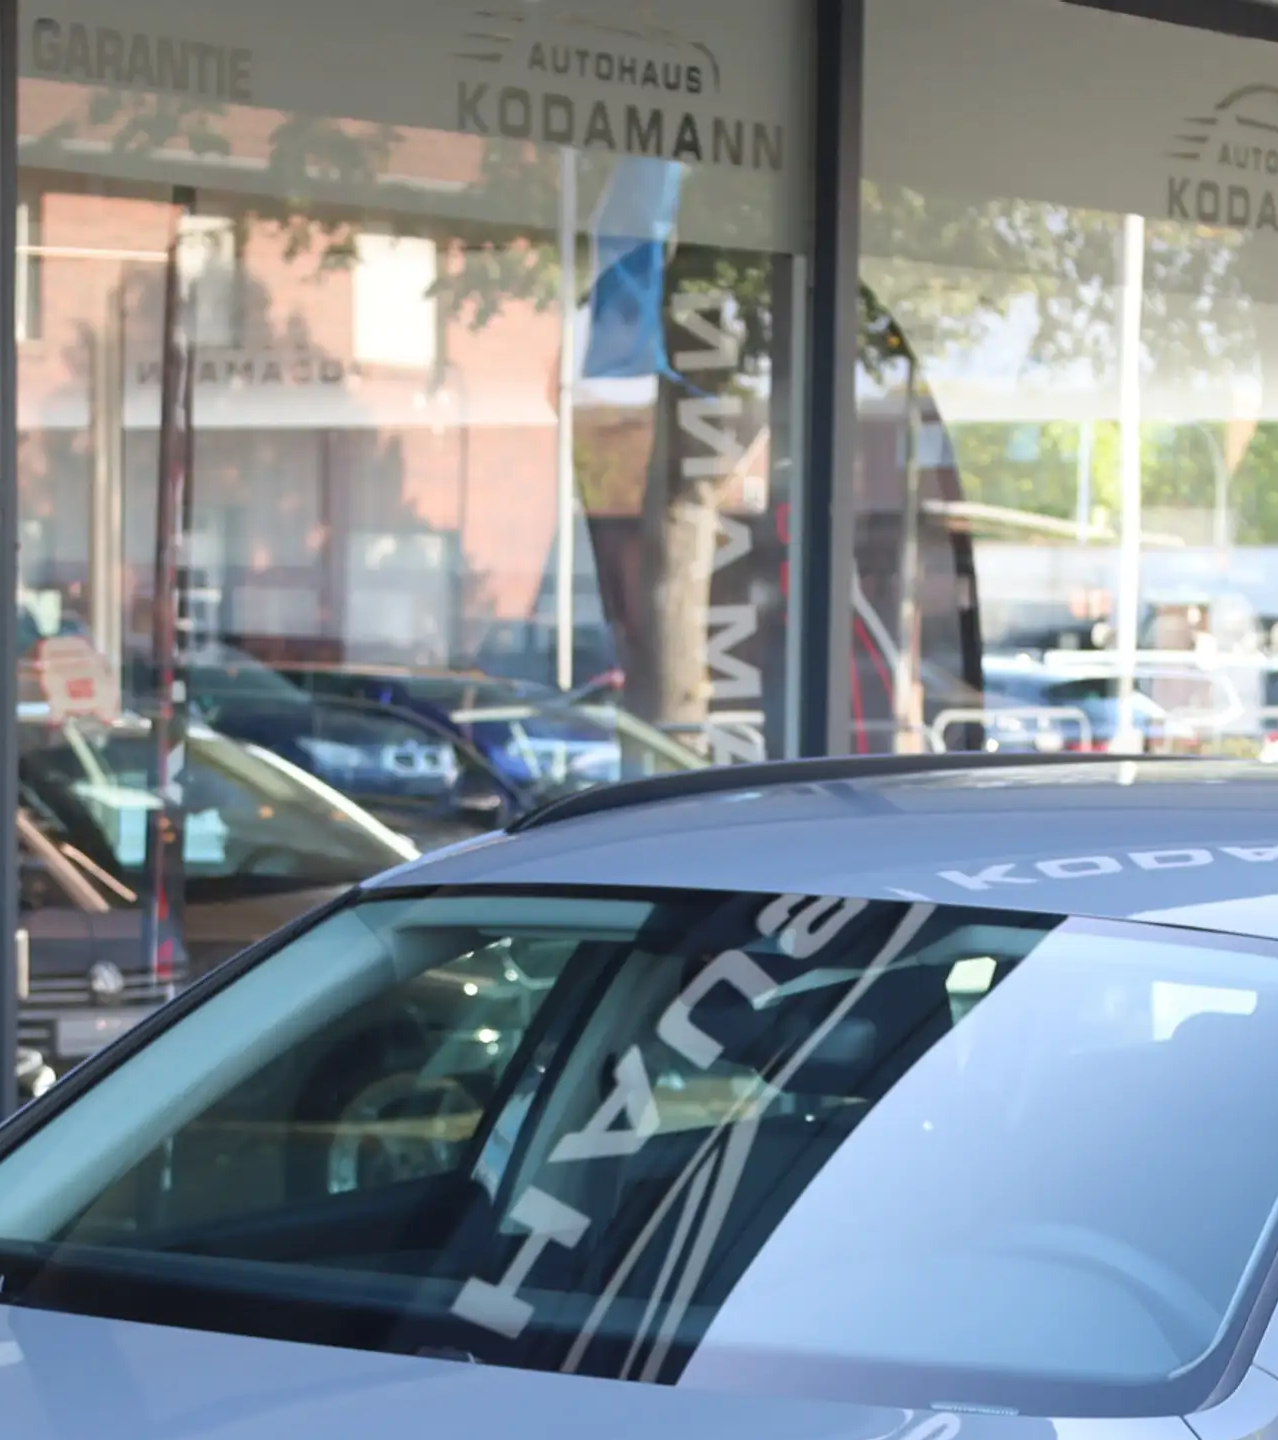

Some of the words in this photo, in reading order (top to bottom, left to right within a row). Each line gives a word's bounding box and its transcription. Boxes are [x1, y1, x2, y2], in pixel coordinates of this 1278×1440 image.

[32, 17, 253, 100] GARANTIE
[527, 41, 702, 94] AUTOHAUS
[456, 80, 785, 171] KODAMANN
